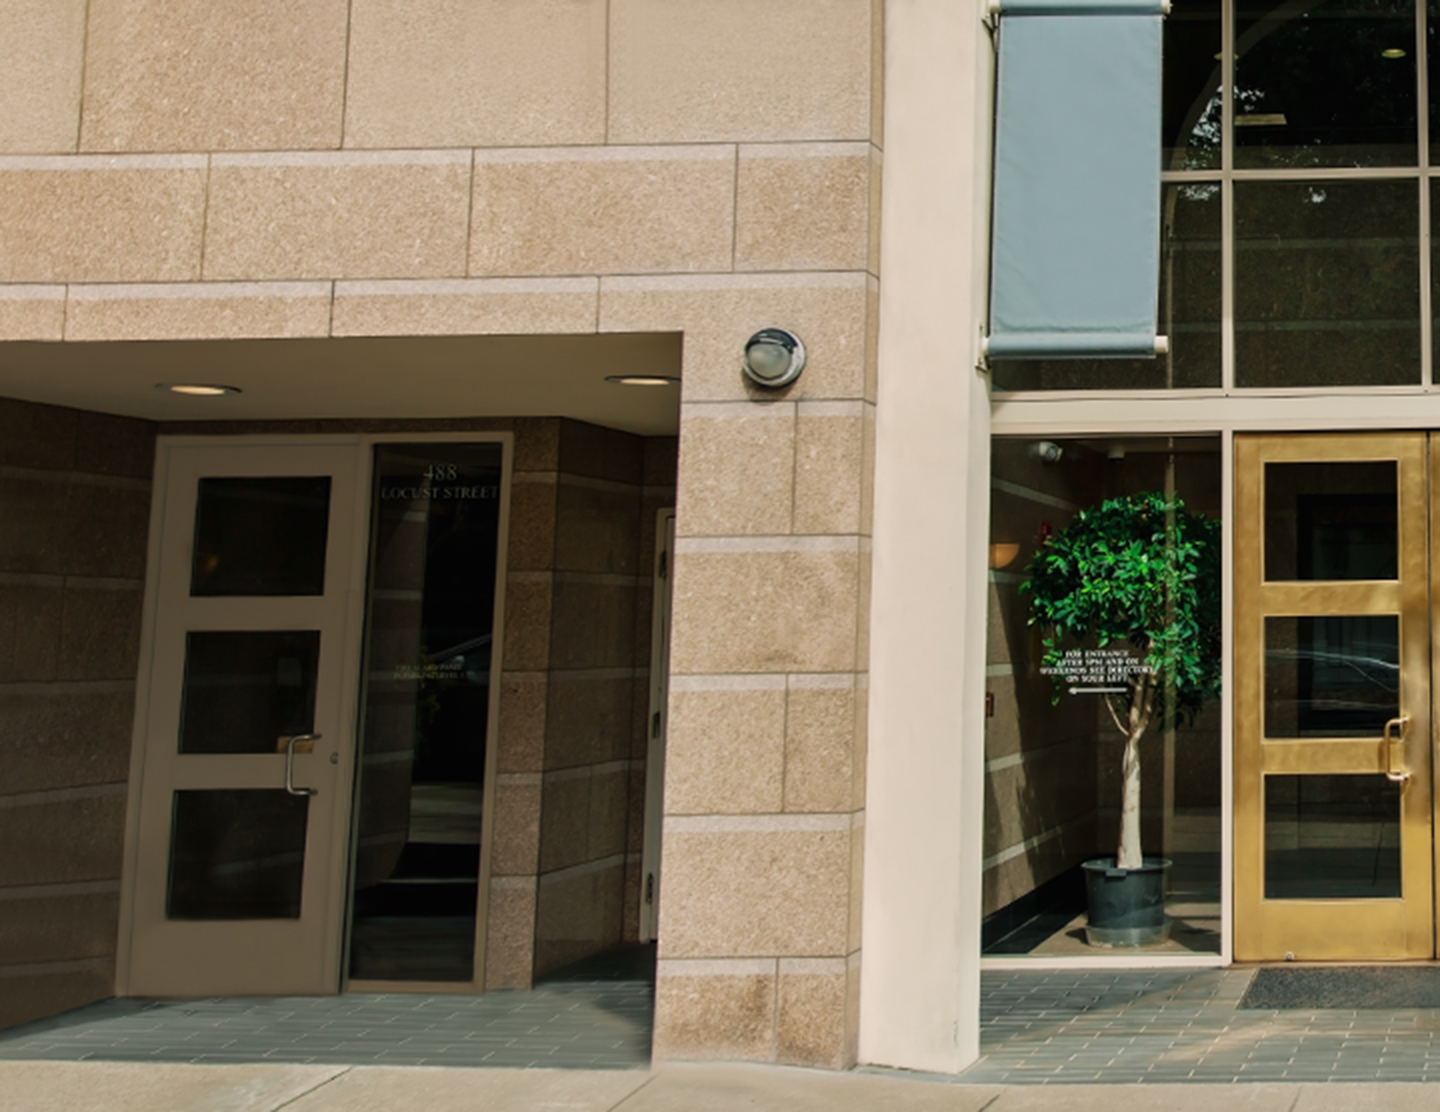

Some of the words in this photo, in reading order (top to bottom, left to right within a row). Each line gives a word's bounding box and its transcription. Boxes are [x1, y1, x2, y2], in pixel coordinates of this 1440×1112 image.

[423, 463, 458, 481] 488
[381, 486, 440, 499] LOCUST
[443, 485, 499, 499] STREET
[1065, 650, 1082, 658] FOR
[1085, 649, 1129, 658] ENTRANCE
[1057, 658, 1082, 667] AFTER
[1105, 658, 1124, 666] AND
[1089, 667, 1106, 675] SEE
[1081, 675, 1105, 683] YOUR
[1107, 674, 1128, 683] LEFT
